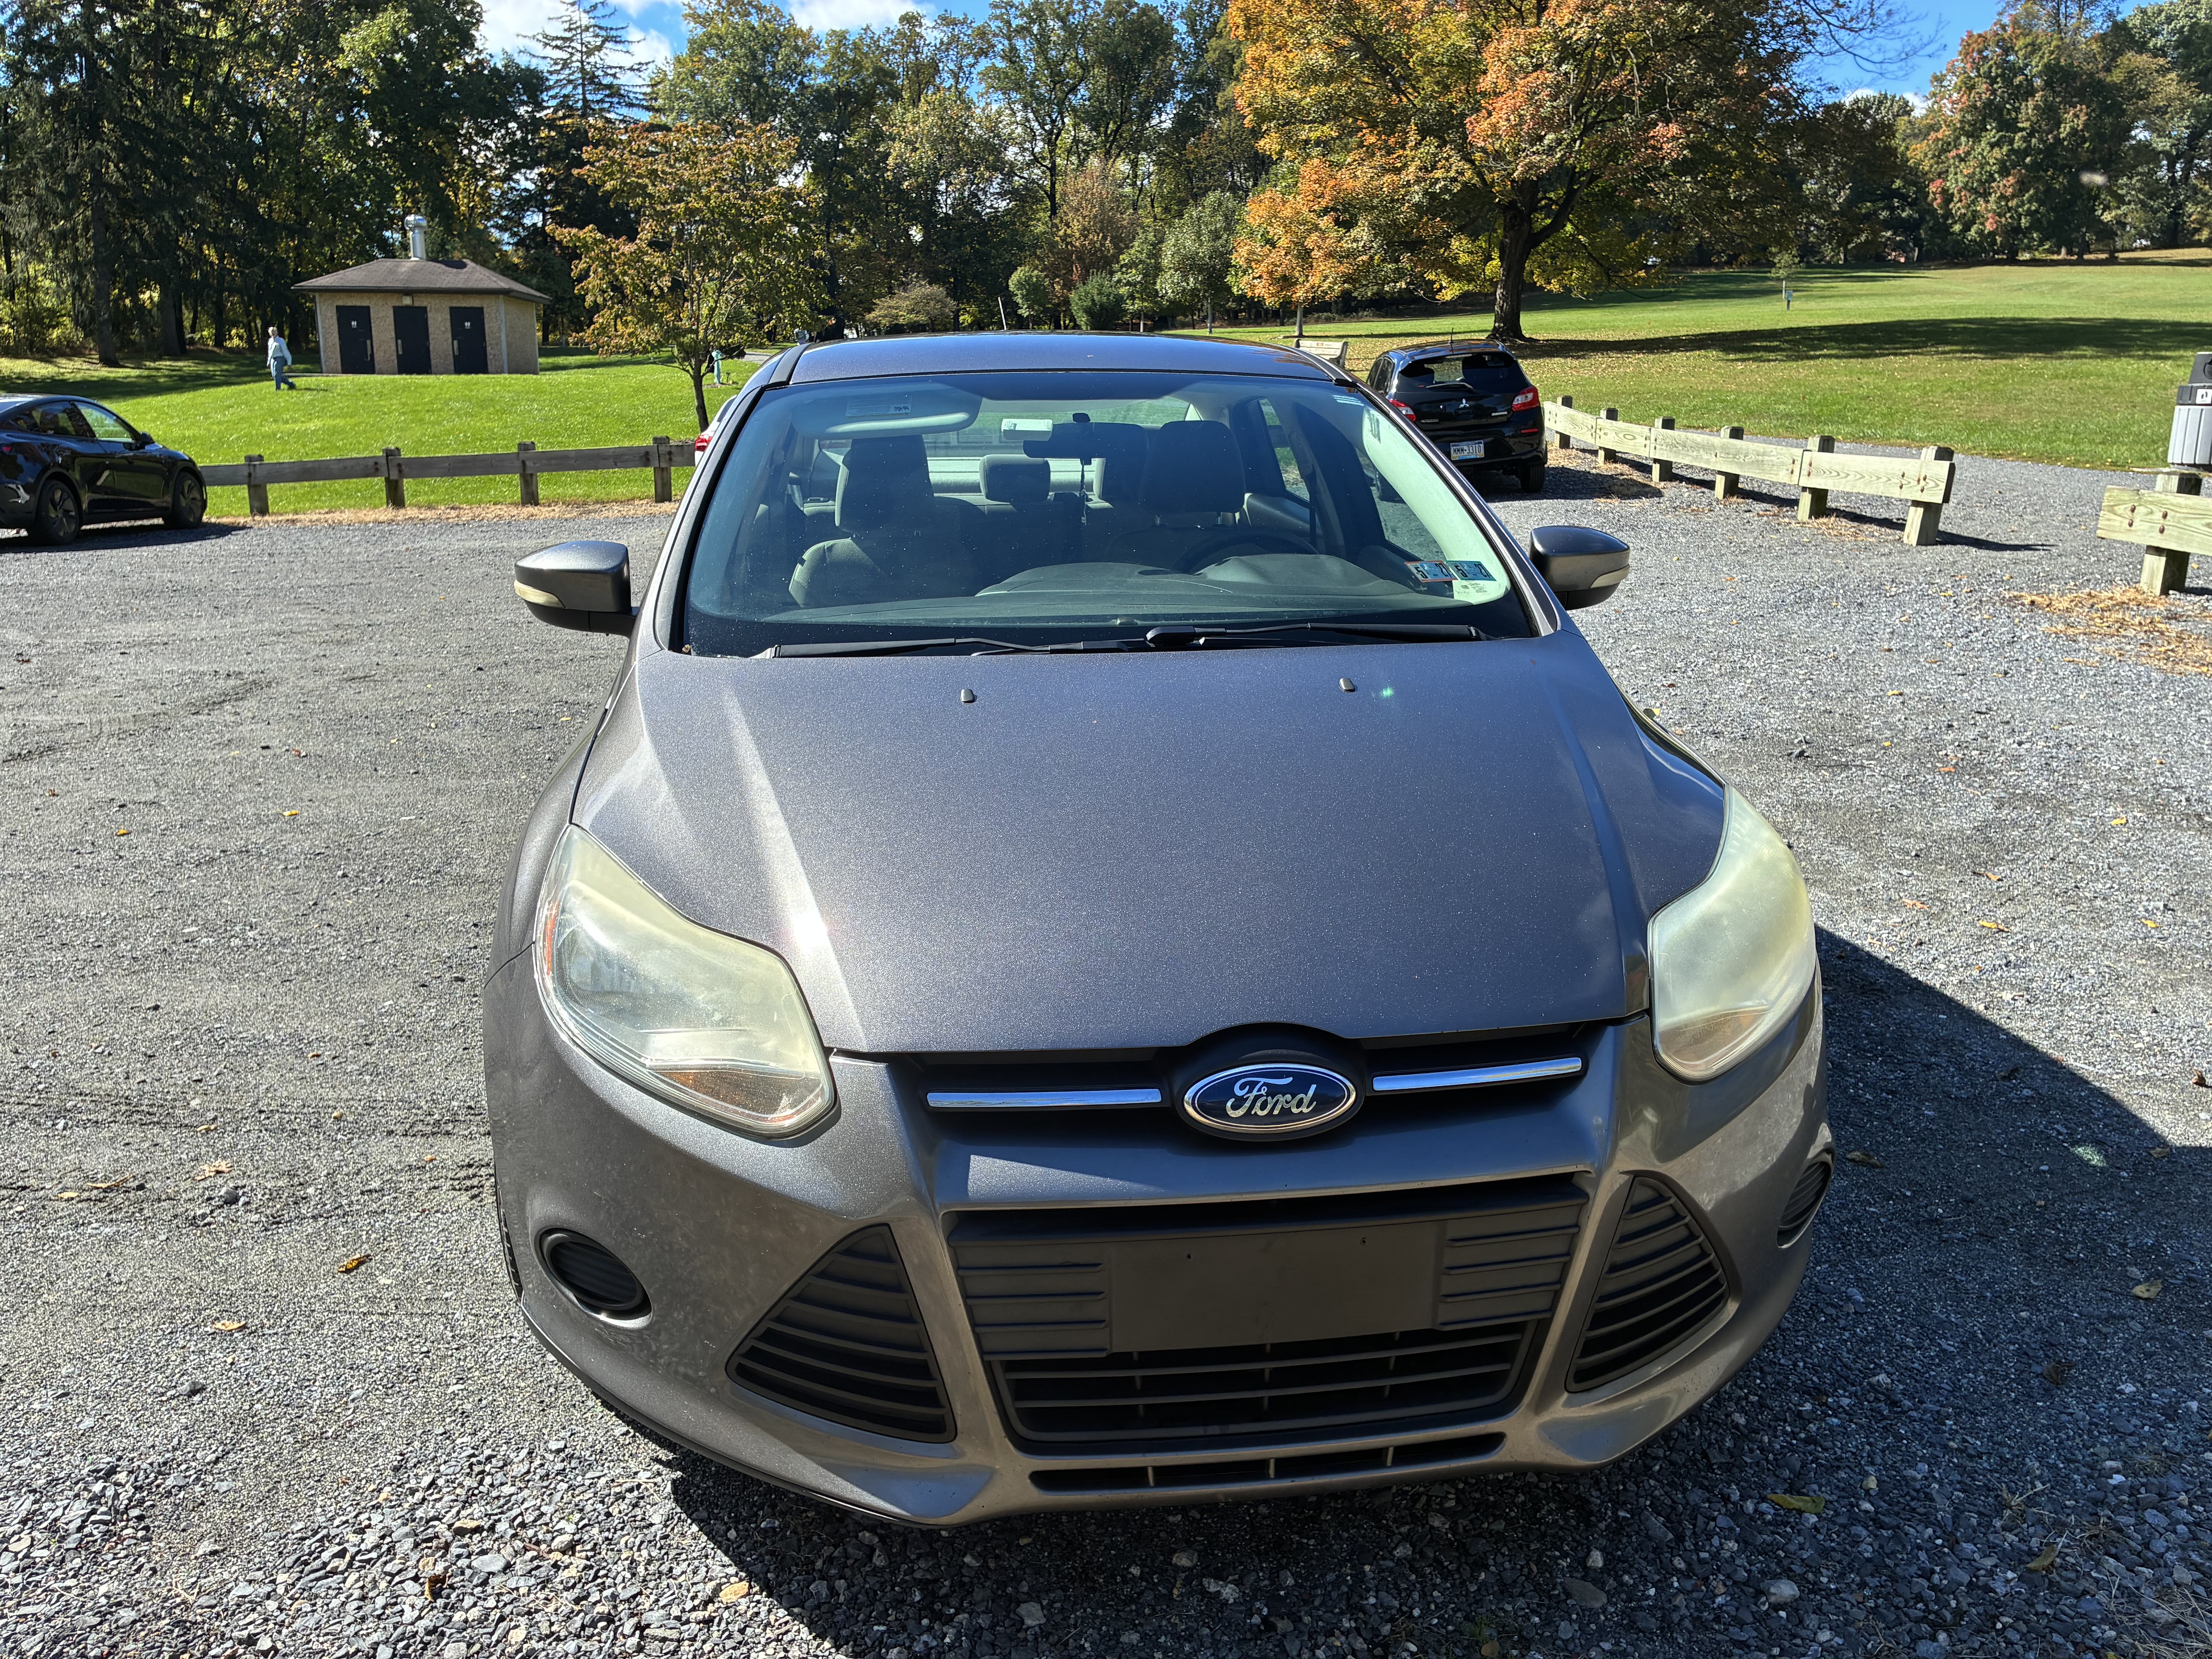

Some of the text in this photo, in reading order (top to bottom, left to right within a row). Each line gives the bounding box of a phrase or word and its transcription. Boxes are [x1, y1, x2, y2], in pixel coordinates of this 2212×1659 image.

[1414, 563, 1452, 579] 5 27
[1454, 563, 1490, 578] 5 27
[1226, 1077, 1317, 1118] Ford
